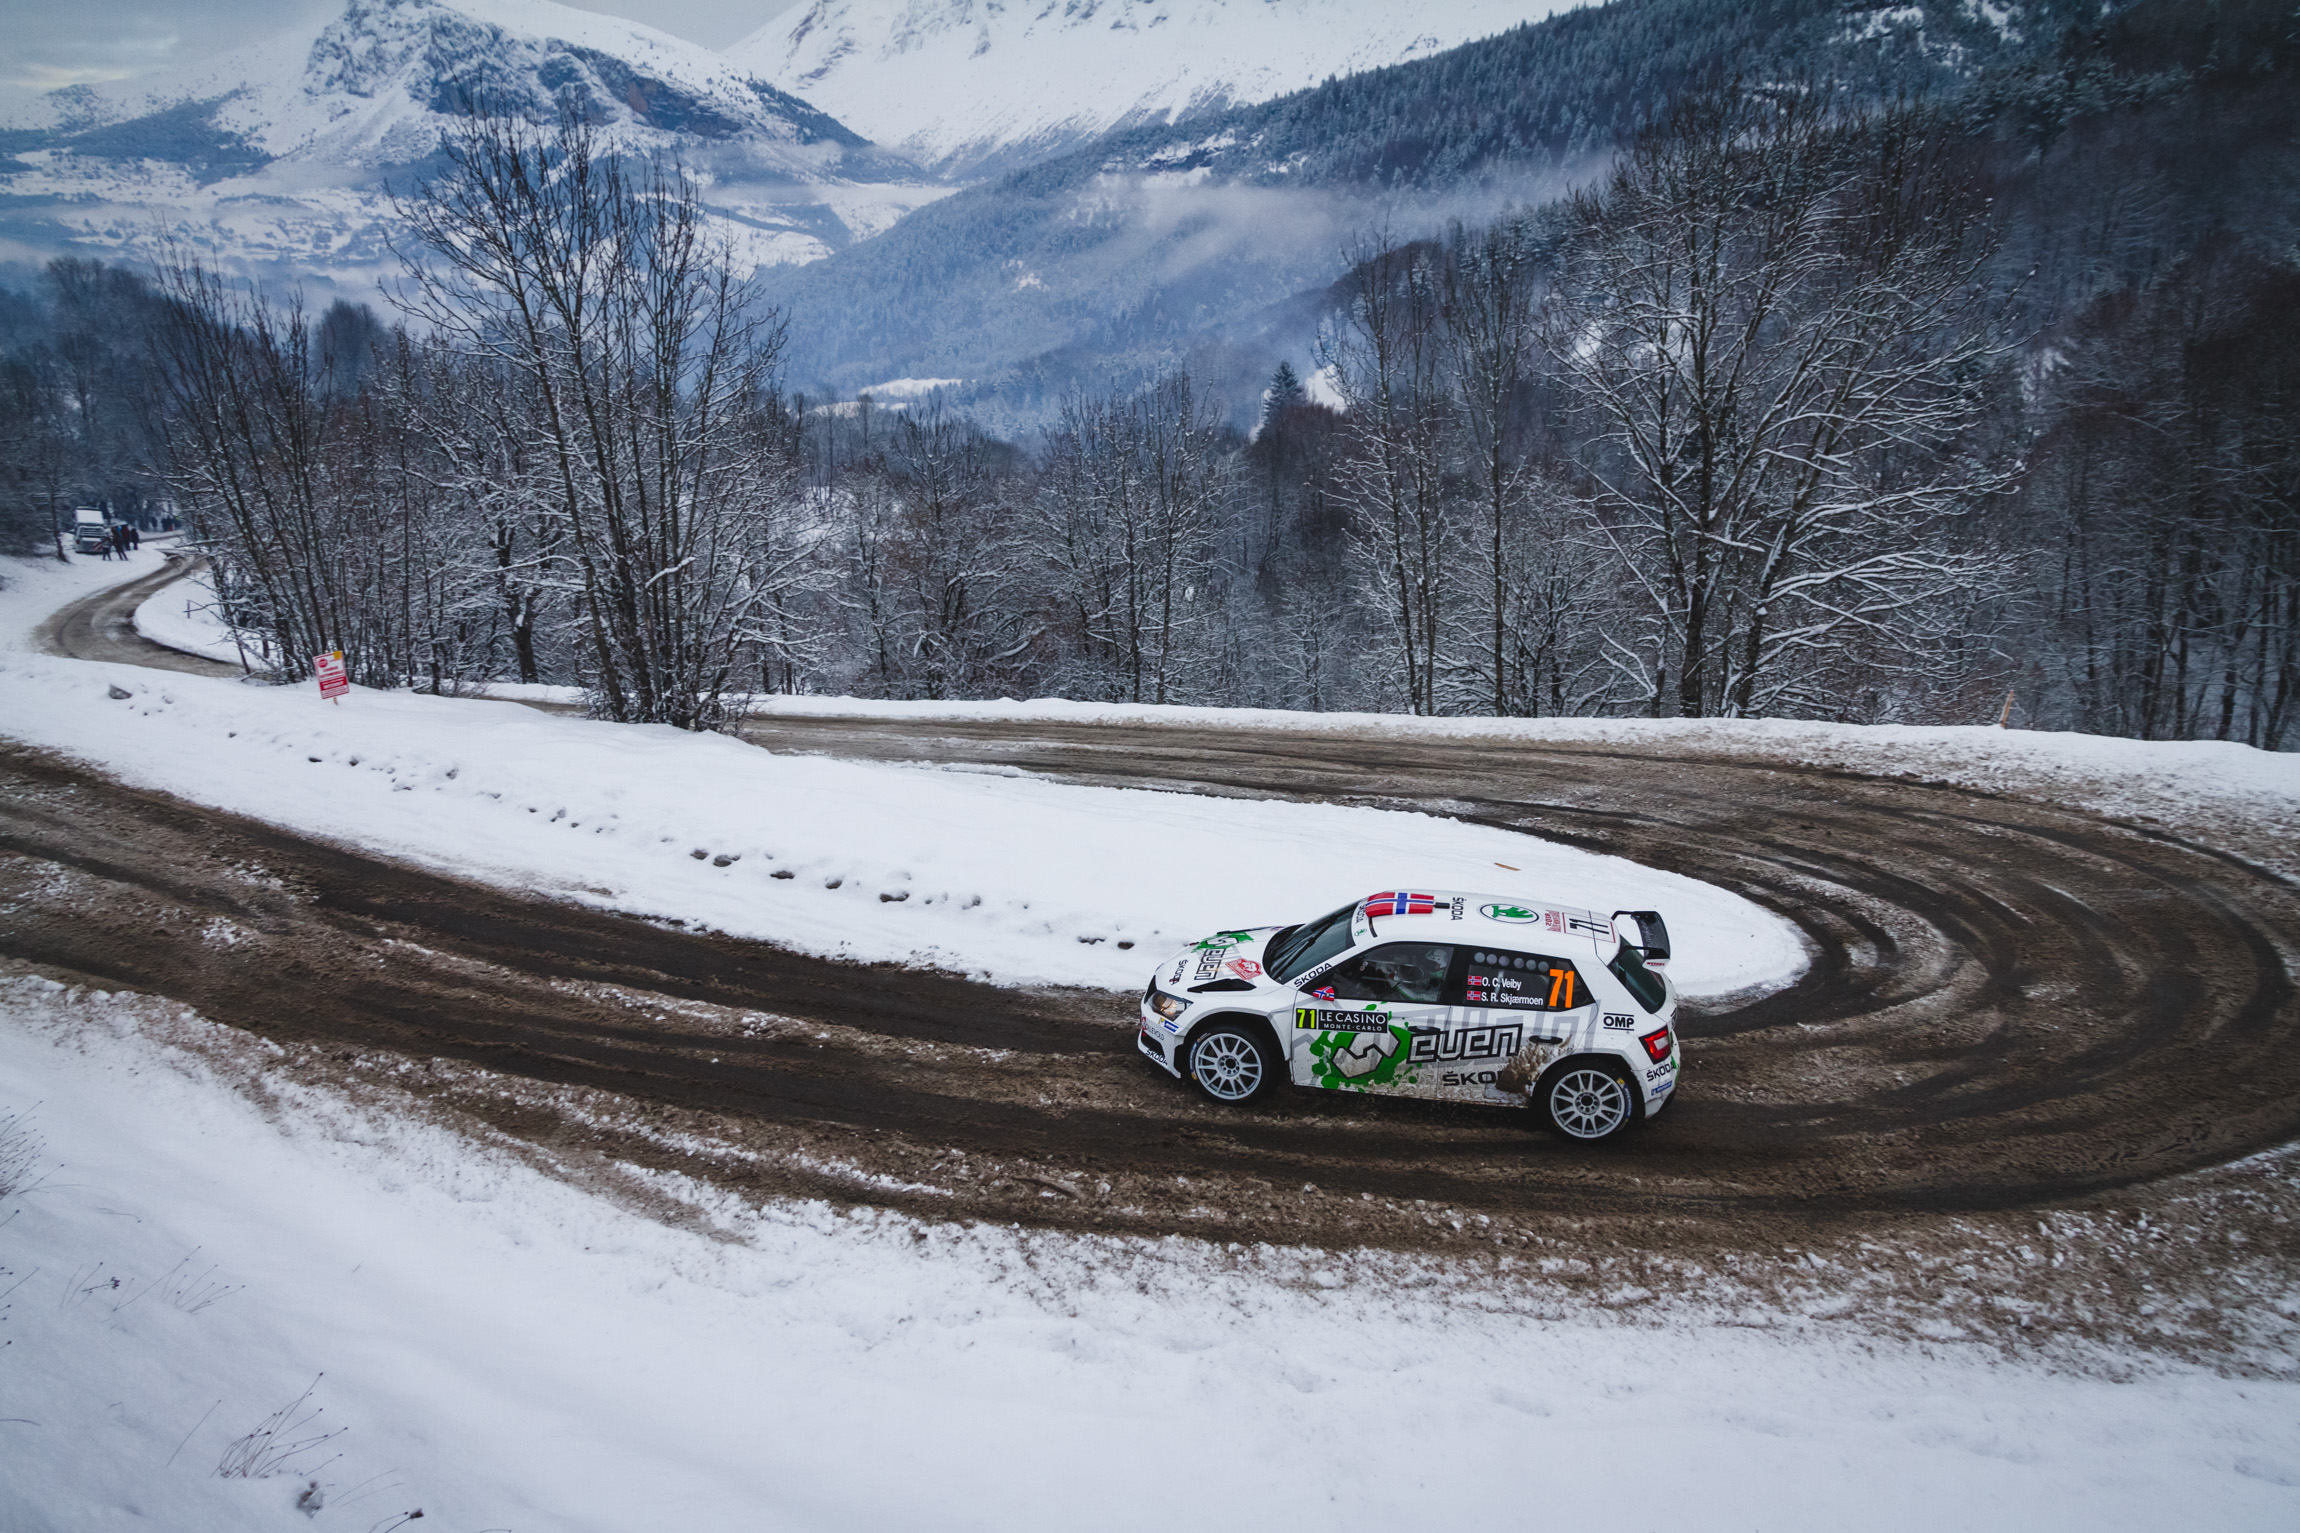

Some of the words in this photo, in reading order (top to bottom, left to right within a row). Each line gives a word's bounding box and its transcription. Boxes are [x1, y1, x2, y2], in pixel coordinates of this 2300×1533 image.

[1450, 896, 1467, 921] ŠKODA
[1569, 918, 1610, 935] 71
[1293, 962, 1333, 988] ŠKODA
[1482, 977, 1491, 987] O.
[1492, 977, 1500, 987] C.
[1502, 978, 1522, 990] Veiby
[1549, 968, 1575, 1009] 71
[1481, 992, 1489, 1002] S.
[1490, 992, 1499, 1003] R.
[1500, 993, 1544, 1006] Skjærmoen
[1297, 1009, 1316, 1029] 71
[1320, 1011, 1333, 1022] LE
[1335, 1012, 1386, 1025] CASINO
[1603, 1016, 1635, 1028] OMP
[1442, 1070, 1506, 1087] ŠKO
